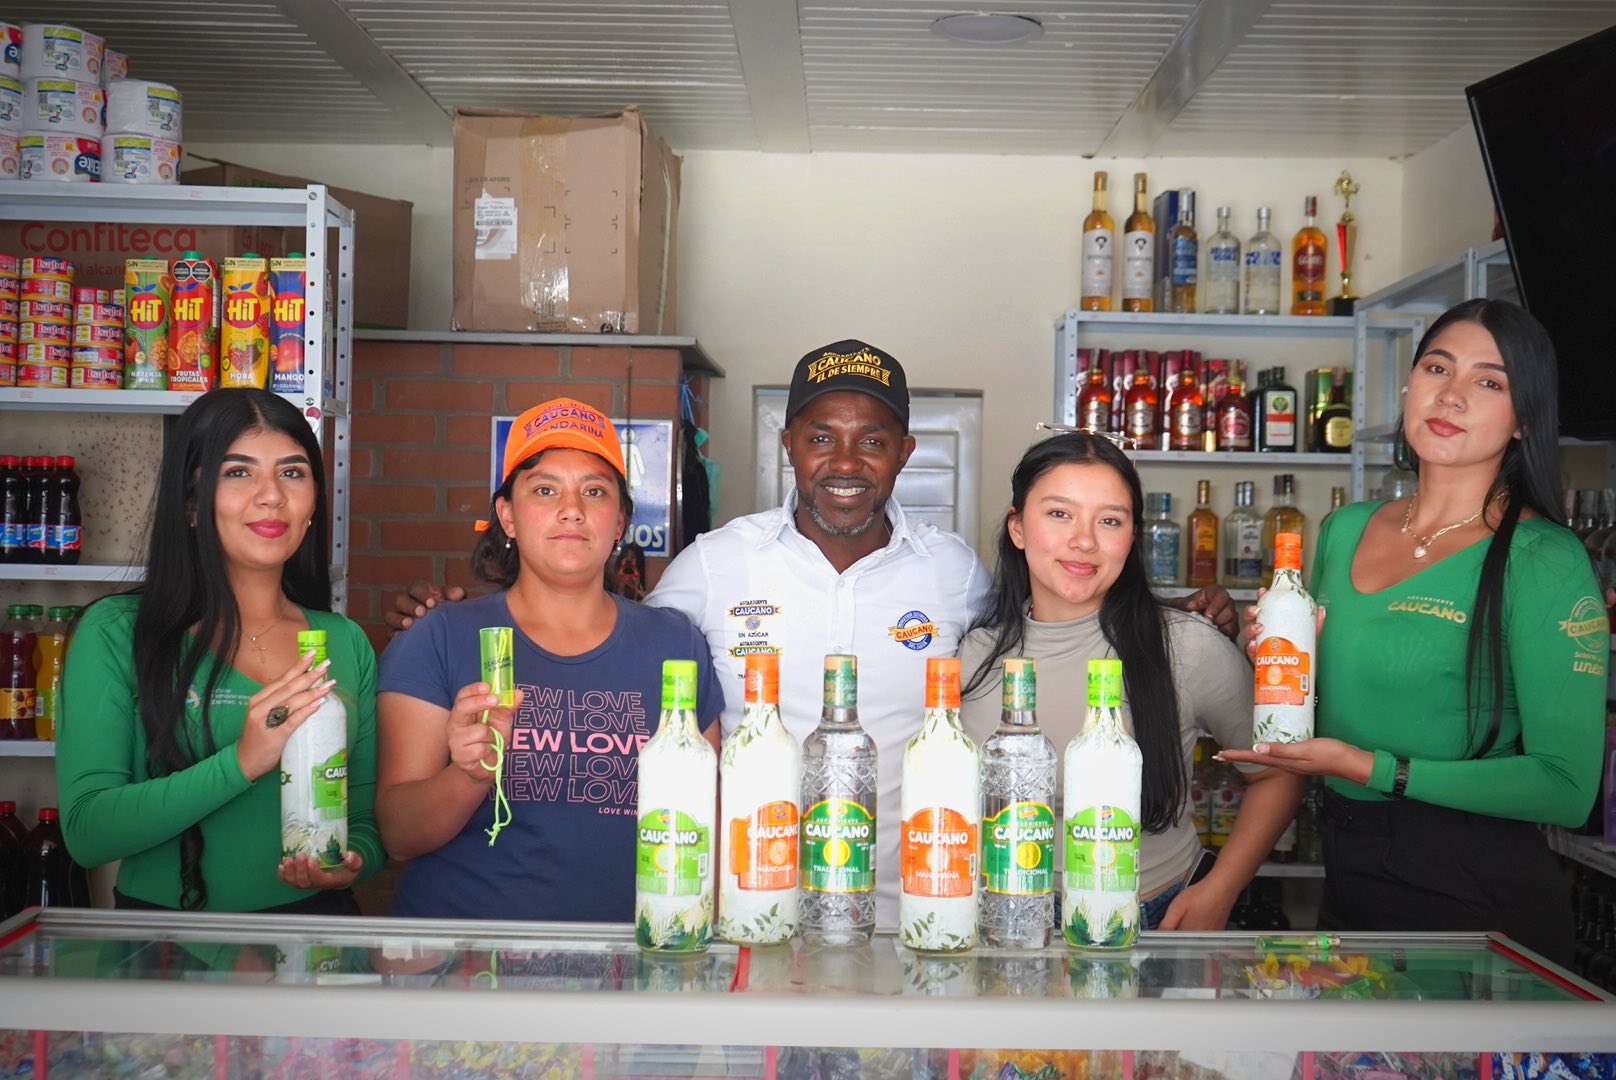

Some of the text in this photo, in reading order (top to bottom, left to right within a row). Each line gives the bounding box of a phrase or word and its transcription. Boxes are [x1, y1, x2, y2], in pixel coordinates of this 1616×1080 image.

[20, 222, 195, 253] Confiteca
[817, 352, 881, 371] CAUCANO
[274, 373, 304, 381] MANGO
[816, 364, 881, 384] EL DE SIEMPRE
[534, 408, 596, 428] CAUCANO
[544, 421, 604, 440] NDARINA
[735, 606, 773, 615] CAUCANO
[1387, 601, 1467, 624] CAUCANO
[896, 624, 934, 639] CAUCANO
[514, 684, 645, 714] EW LOVE
[513, 708, 650, 734] EW LOVE
[507, 728, 563, 752] EW
[570, 755, 638, 780] LOV
[598, 807, 620, 815] LOVE
[640, 828, 698, 844] CAUCANO
[1073, 825, 1133, 840] CAUCANO
